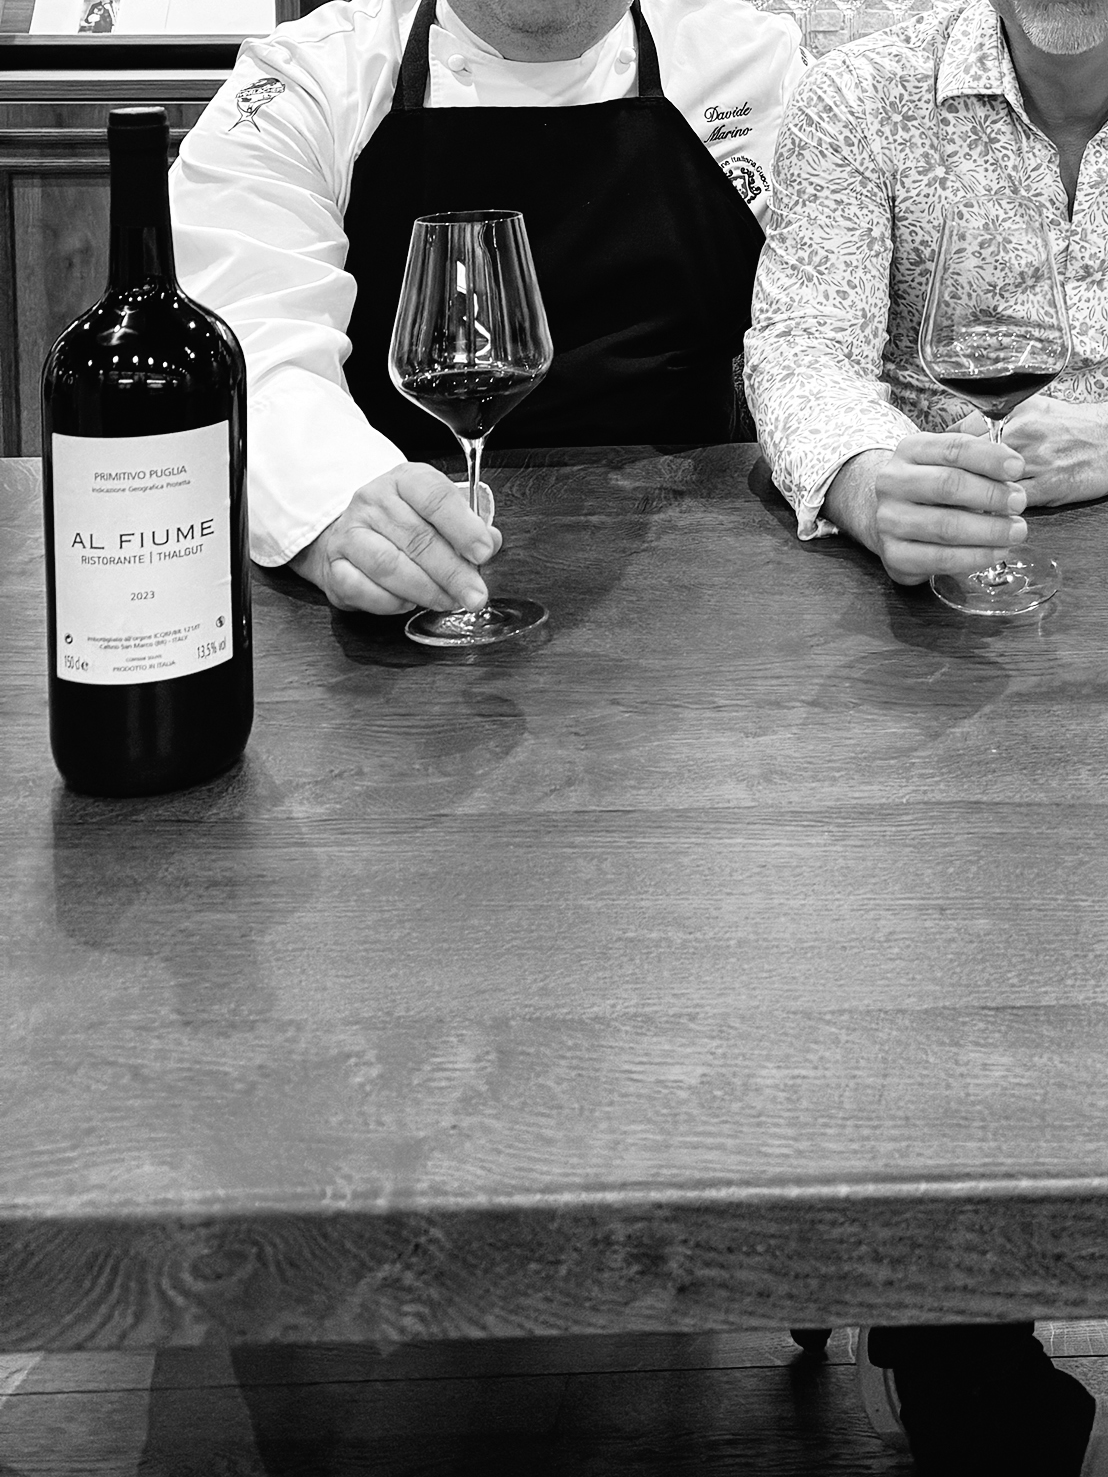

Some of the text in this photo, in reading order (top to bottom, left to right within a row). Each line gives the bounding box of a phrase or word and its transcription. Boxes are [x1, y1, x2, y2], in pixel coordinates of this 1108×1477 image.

[704, 101, 752, 123] Davide
[703, 124, 753, 143] Marino
[94, 465, 187, 482] PRIMITIVO PUGLIA
[128, 484, 164, 493] Geografica
[71, 518, 215, 550] AL FIUME
[81, 554, 145, 566] RISTORANTE
[156, 544, 204, 562] THALGUT
[130, 591, 155, 601] 2023
[197, 640, 217, 659] 13,5%
